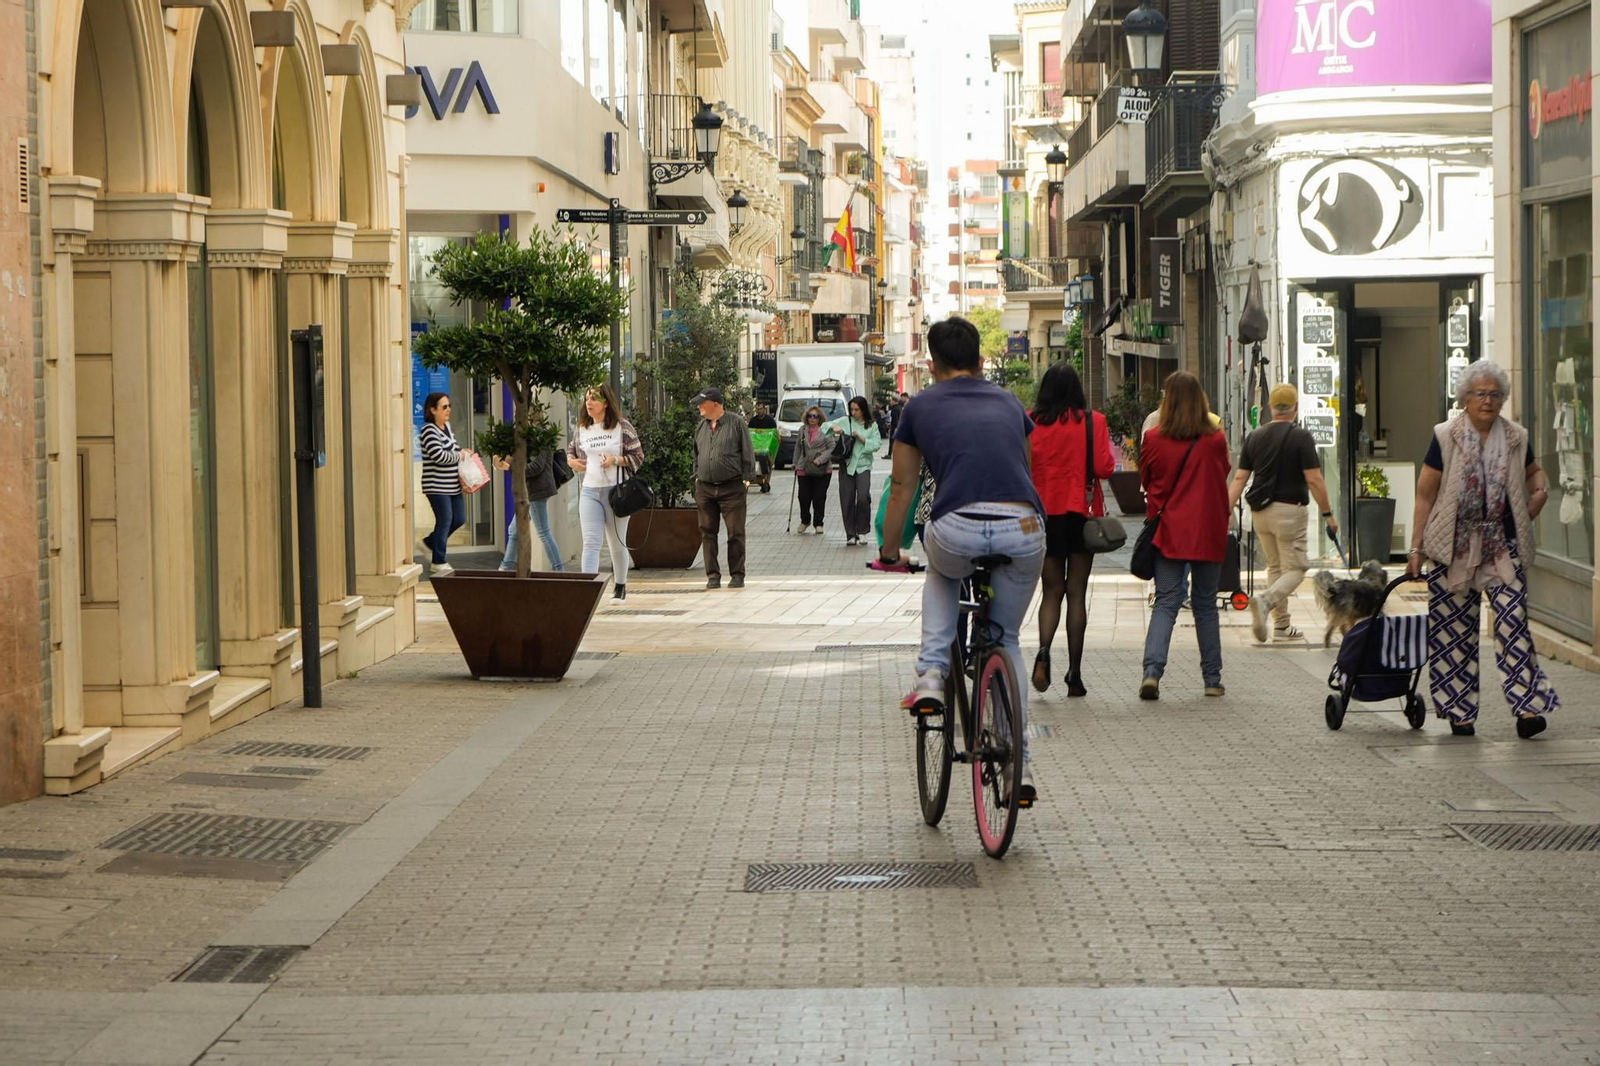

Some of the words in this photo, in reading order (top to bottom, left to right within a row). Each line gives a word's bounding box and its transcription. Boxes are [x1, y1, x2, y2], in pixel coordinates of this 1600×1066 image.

[1124, 99, 1150, 112] ALQU
[1120, 111, 1147, 121] OFIC
[1160, 253, 1171, 308] TIGER
[756, 352, 776, 360] TEATRO
[586, 434, 612, 443] COMMON
